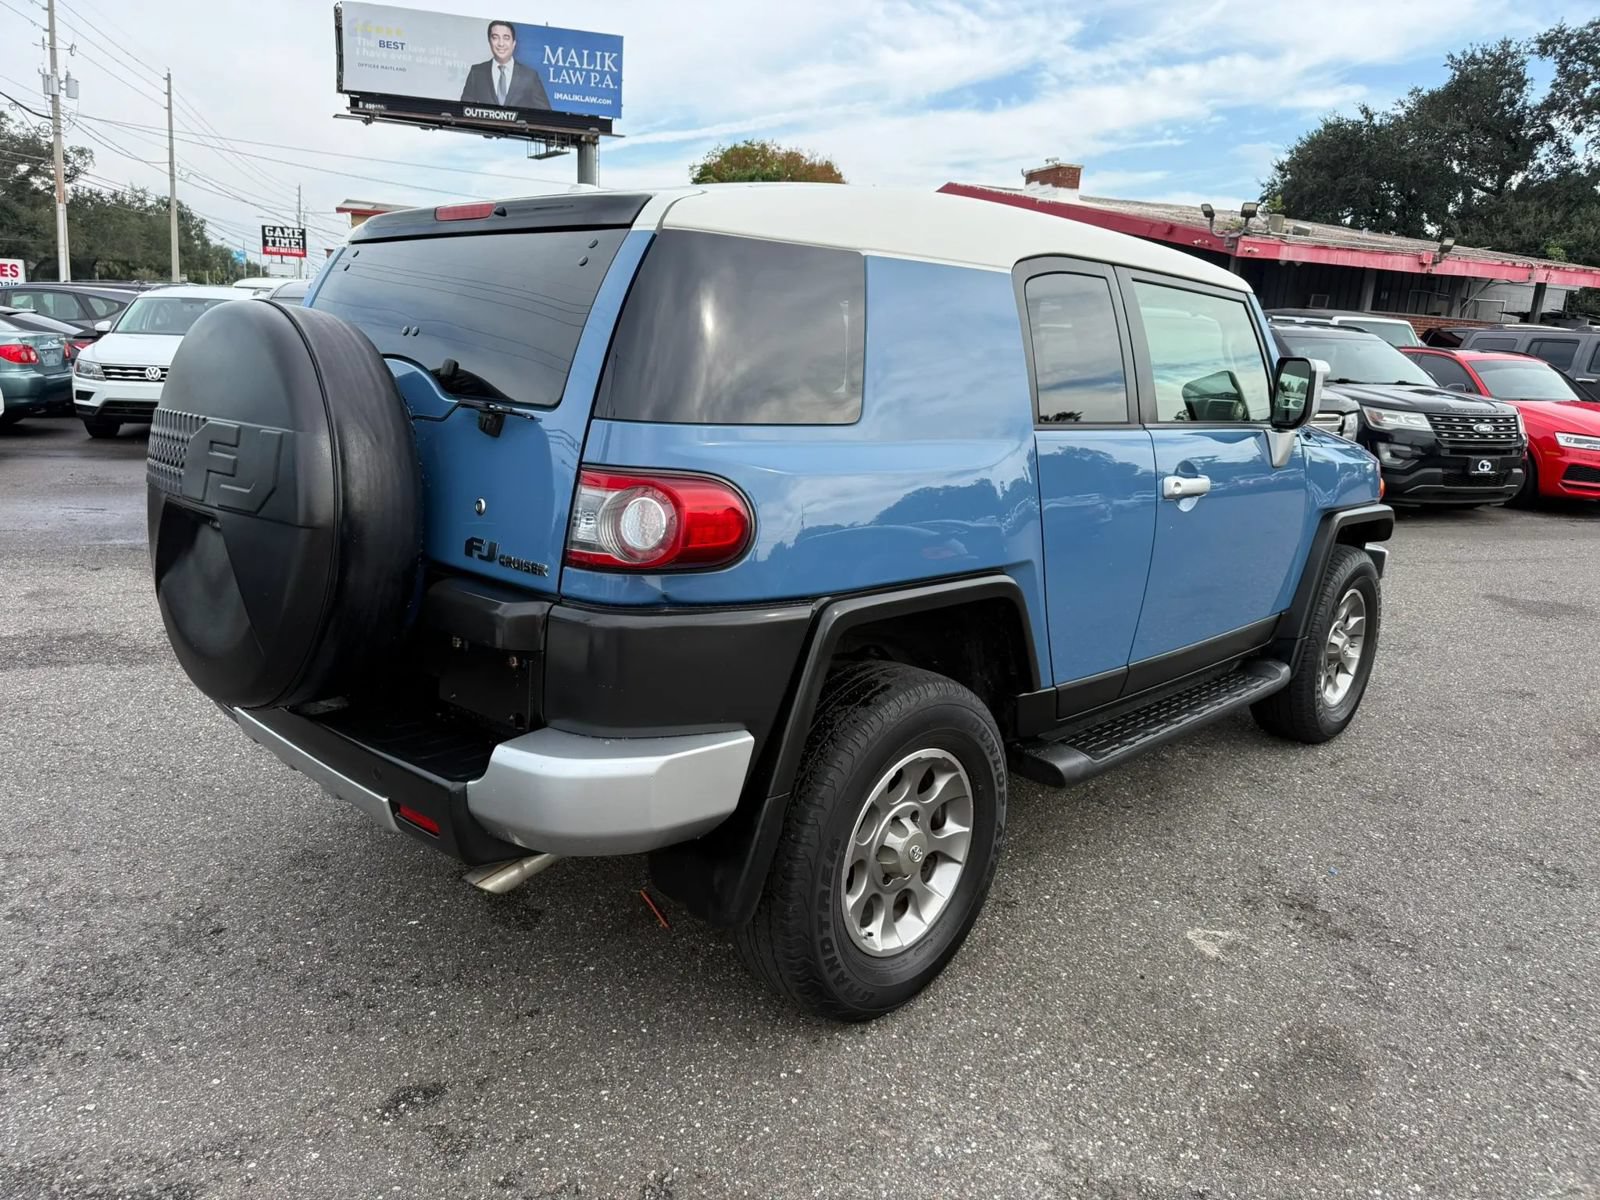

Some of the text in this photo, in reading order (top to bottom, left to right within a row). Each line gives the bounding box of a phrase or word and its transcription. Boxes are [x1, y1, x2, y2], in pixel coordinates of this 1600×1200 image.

[379, 40, 406, 51] BEST
[543, 45, 618, 72] MALIK
[549, 67, 618, 89] LAW P.A.
[265, 226, 303, 239] GAME
[265, 236, 304, 249] TIME!
[464, 536, 548, 577] FJ CRUISER
